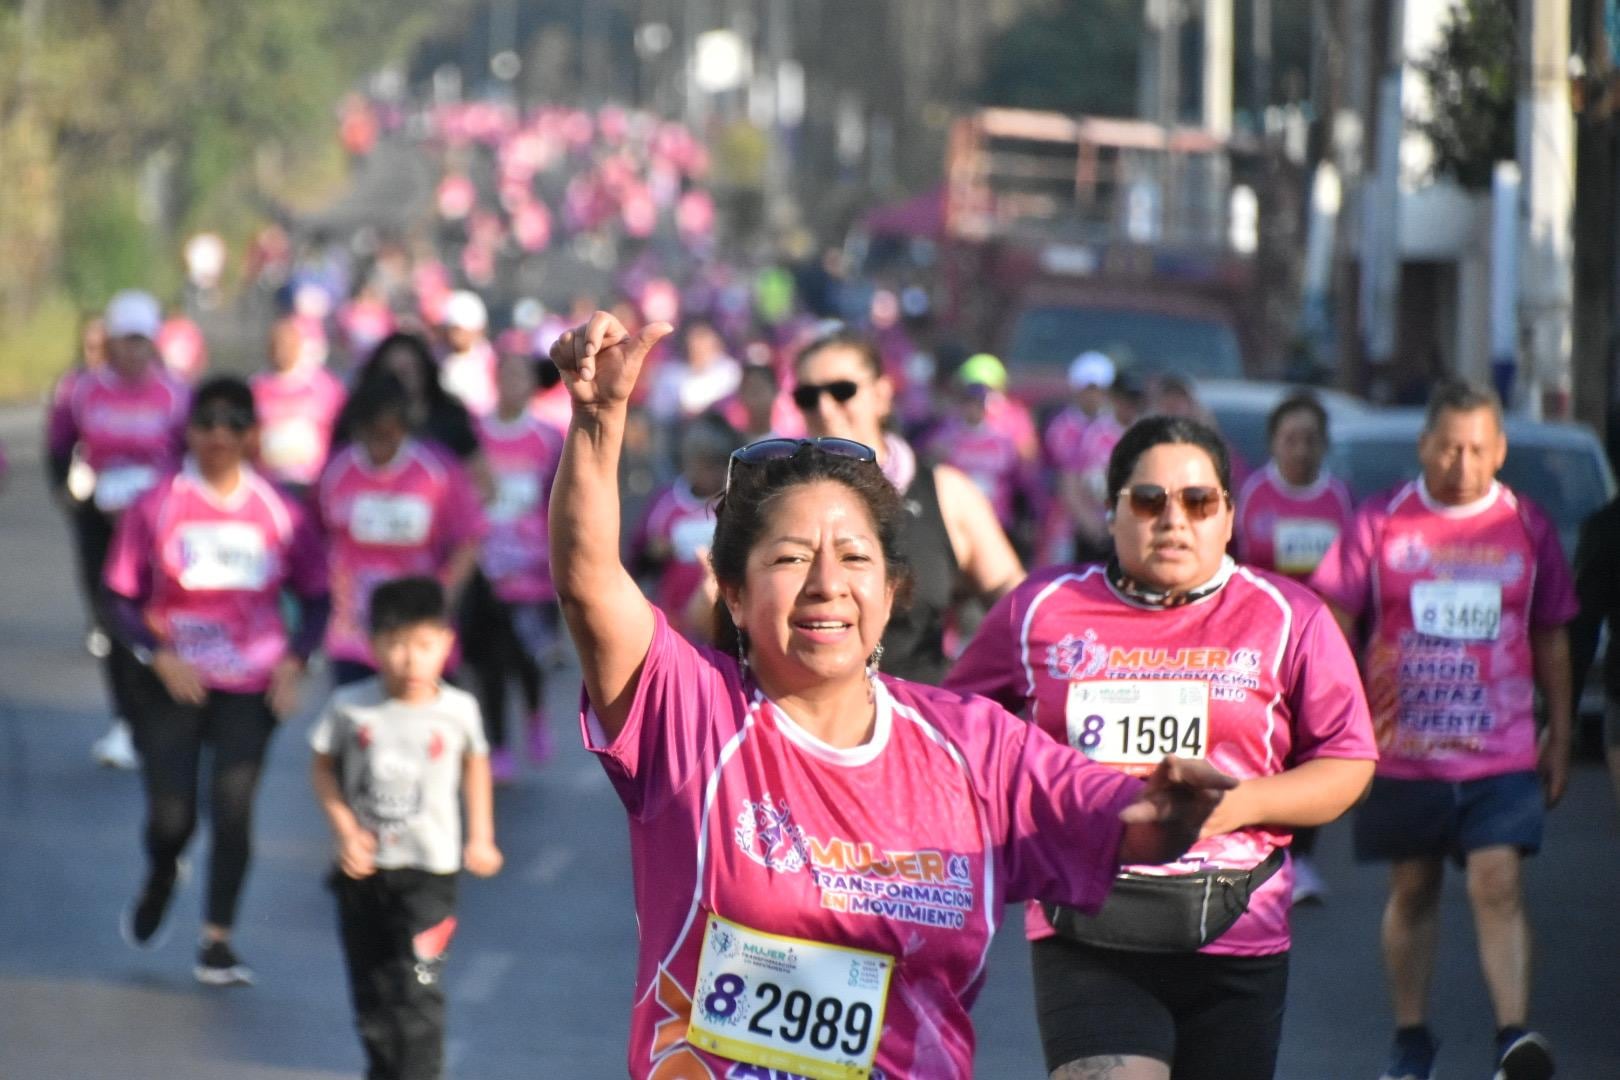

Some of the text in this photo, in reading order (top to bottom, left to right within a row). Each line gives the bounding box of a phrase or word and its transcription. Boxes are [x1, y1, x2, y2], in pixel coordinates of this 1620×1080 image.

[1109, 648, 1228, 668] MUJER
[1078, 714, 1202, 756] 8 1594
[809, 837, 945, 882] MUJER
[811, 869, 973, 909] TRANSFORMACIÓN
[822, 892, 965, 928] EN MOVIMIENTO
[704, 973, 873, 1056] 8 2989
